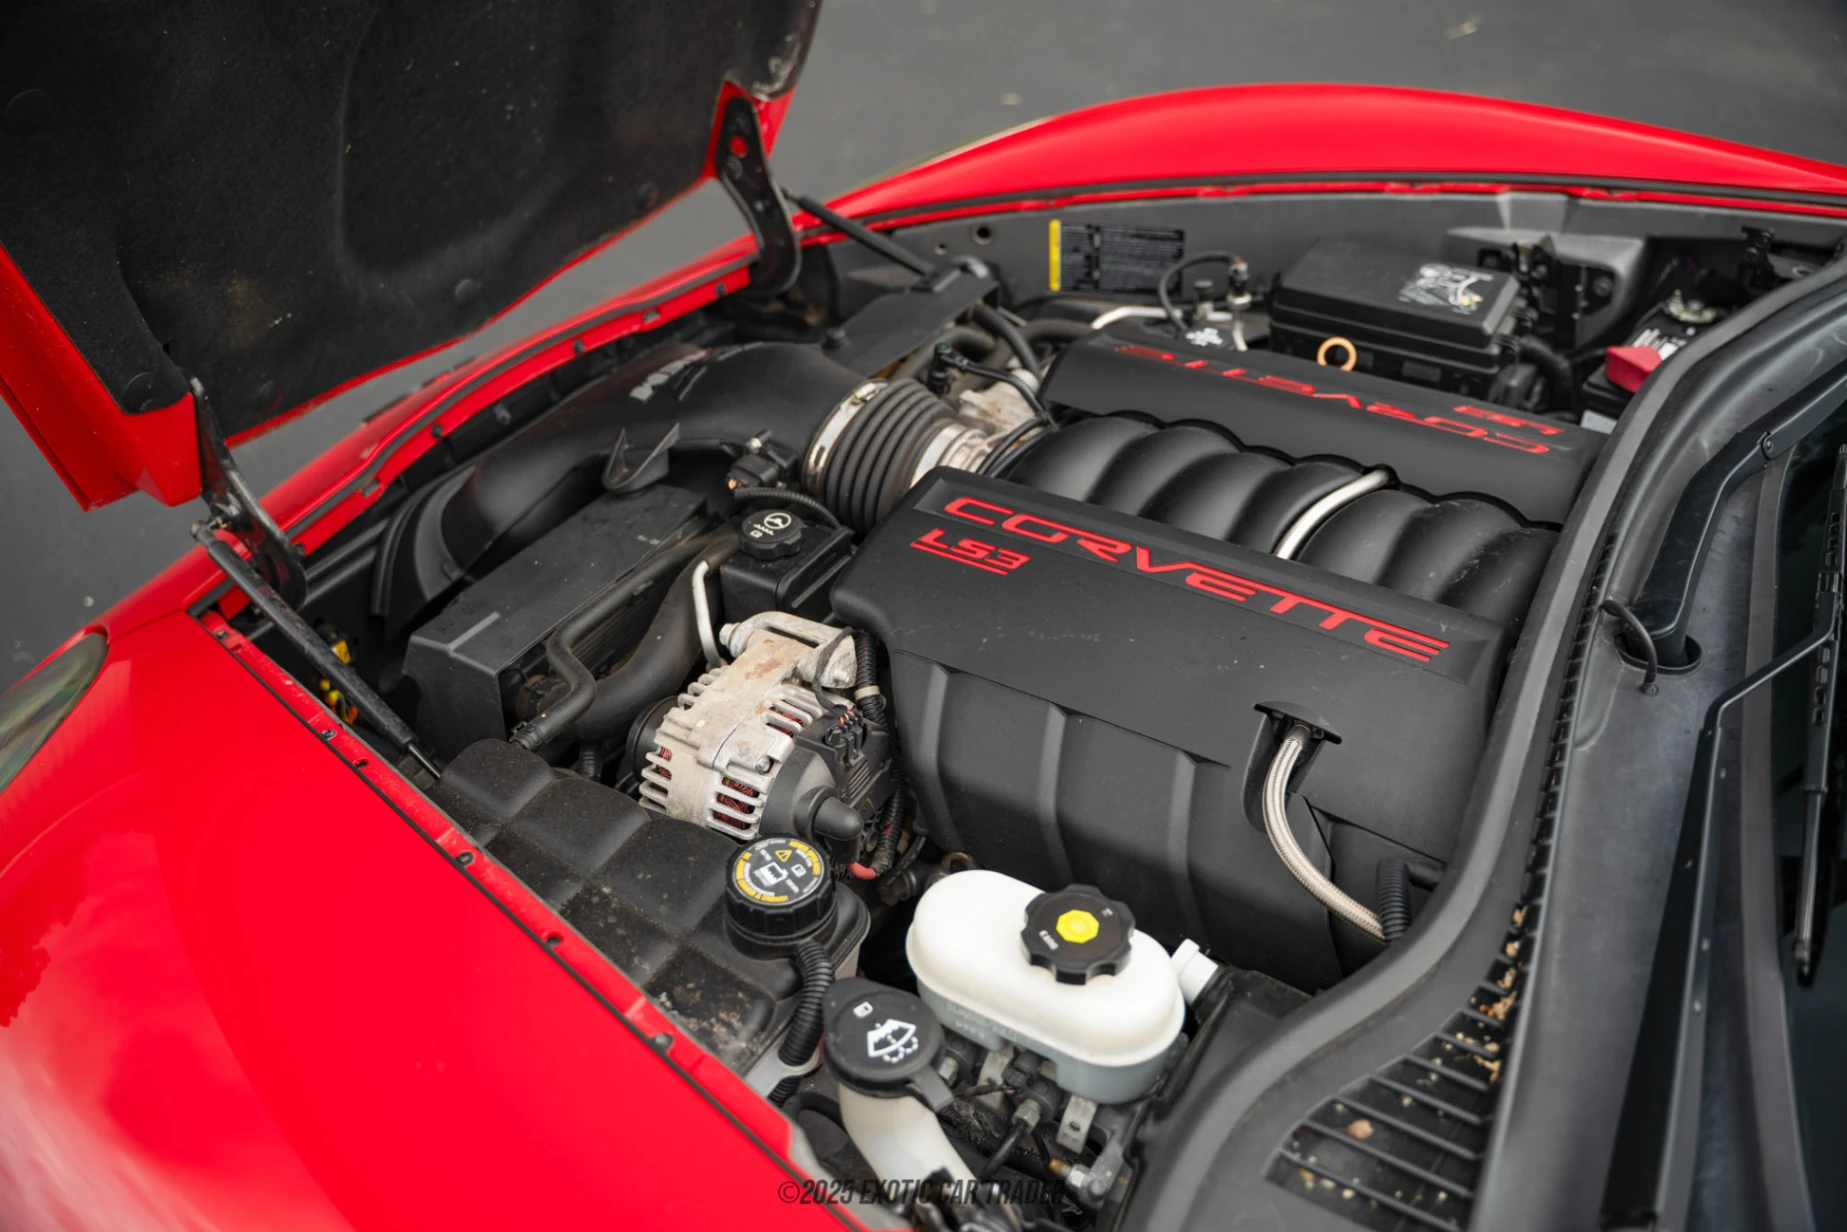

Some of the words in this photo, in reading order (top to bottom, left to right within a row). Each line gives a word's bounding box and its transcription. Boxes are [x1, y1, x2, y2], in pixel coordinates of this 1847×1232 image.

[1115, 345, 1551, 455] CORVETTE
[909, 527, 1032, 577] LS3
[944, 496, 1451, 663] CORVETTE
